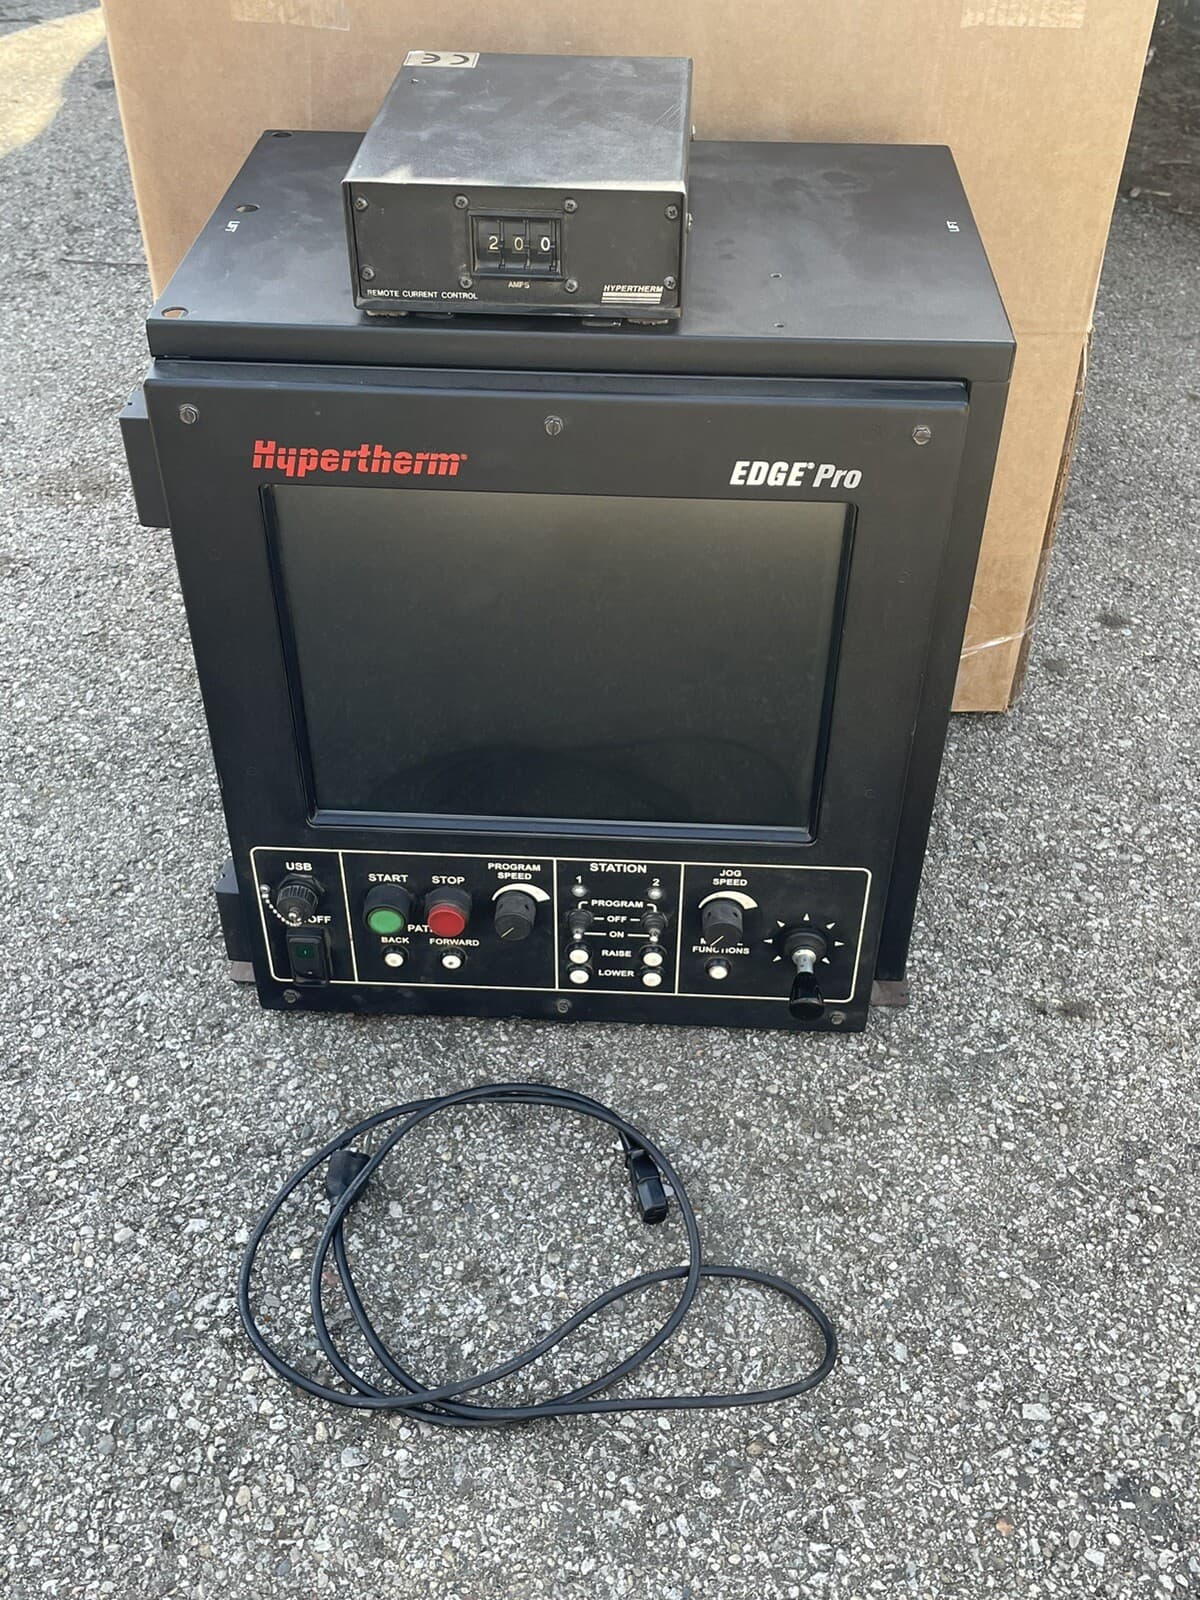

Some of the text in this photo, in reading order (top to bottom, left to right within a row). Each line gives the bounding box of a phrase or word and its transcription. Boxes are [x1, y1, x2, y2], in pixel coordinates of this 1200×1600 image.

[507, 281, 531, 289] AMPS
[603, 284, 664, 293] HYPERTHERM
[366, 289, 479, 300] REMOTE CURRENT CONTROL
[812, 463, 862, 489] Pro
[285, 861, 313, 872] USB
[487, 862, 541, 872] PROGRAM
[589, 862, 648, 874] STATION
[497, 871, 533, 881] SPEED
[719, 868, 742, 878] JOG
[368, 873, 409, 883] START
[431, 875, 466, 885] STOP
[575, 875, 582, 884] 1
[652, 878, 661, 887] 2
[712, 878, 748, 887] SPEED
[591, 899, 644, 909] PROGRAM
[606, 915, 628, 923] OFF
[407, 924, 433, 933] PAT
[608, 931, 625, 939] ON
[380, 936, 410, 945] BACK
[429, 938, 480, 947] FORWARD
[601, 949, 632, 958] RAISE
[598, 969, 635, 978] LOWER
